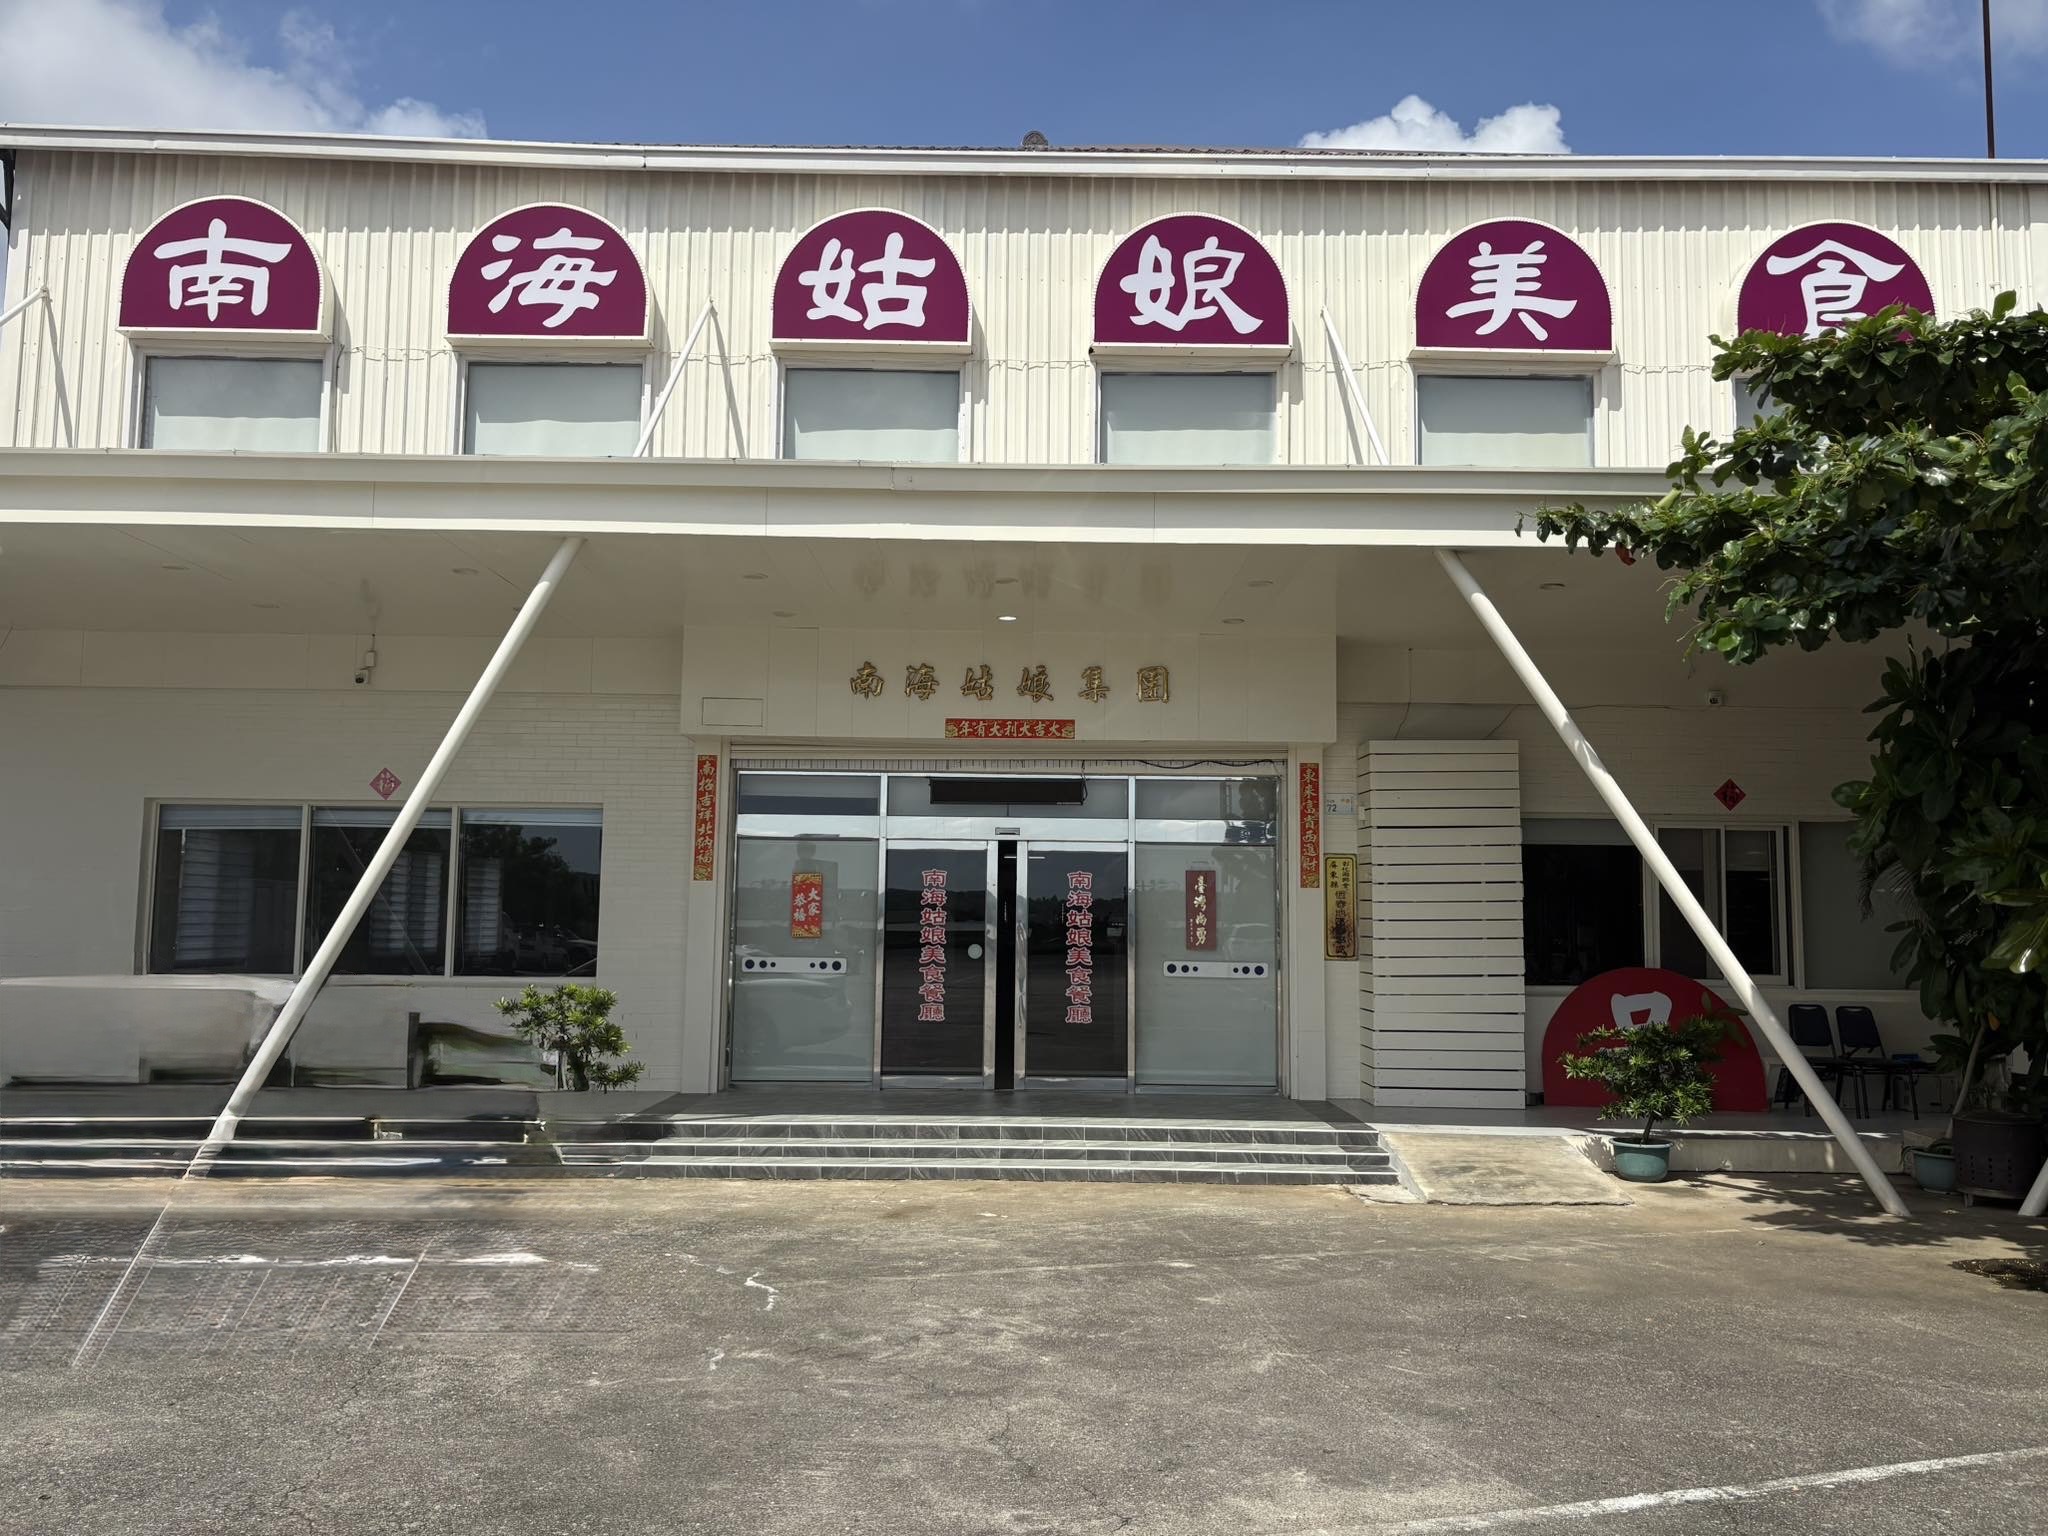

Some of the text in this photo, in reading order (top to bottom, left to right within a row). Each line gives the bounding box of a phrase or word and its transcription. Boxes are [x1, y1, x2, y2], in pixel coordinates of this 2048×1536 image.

[154, 217, 1906, 340] 南海姑娘美食
[918, 869, 948, 1022] 南海姑娘美食餐廳
[1065, 871, 1093, 1024] 南海姑娘美食餐廳
